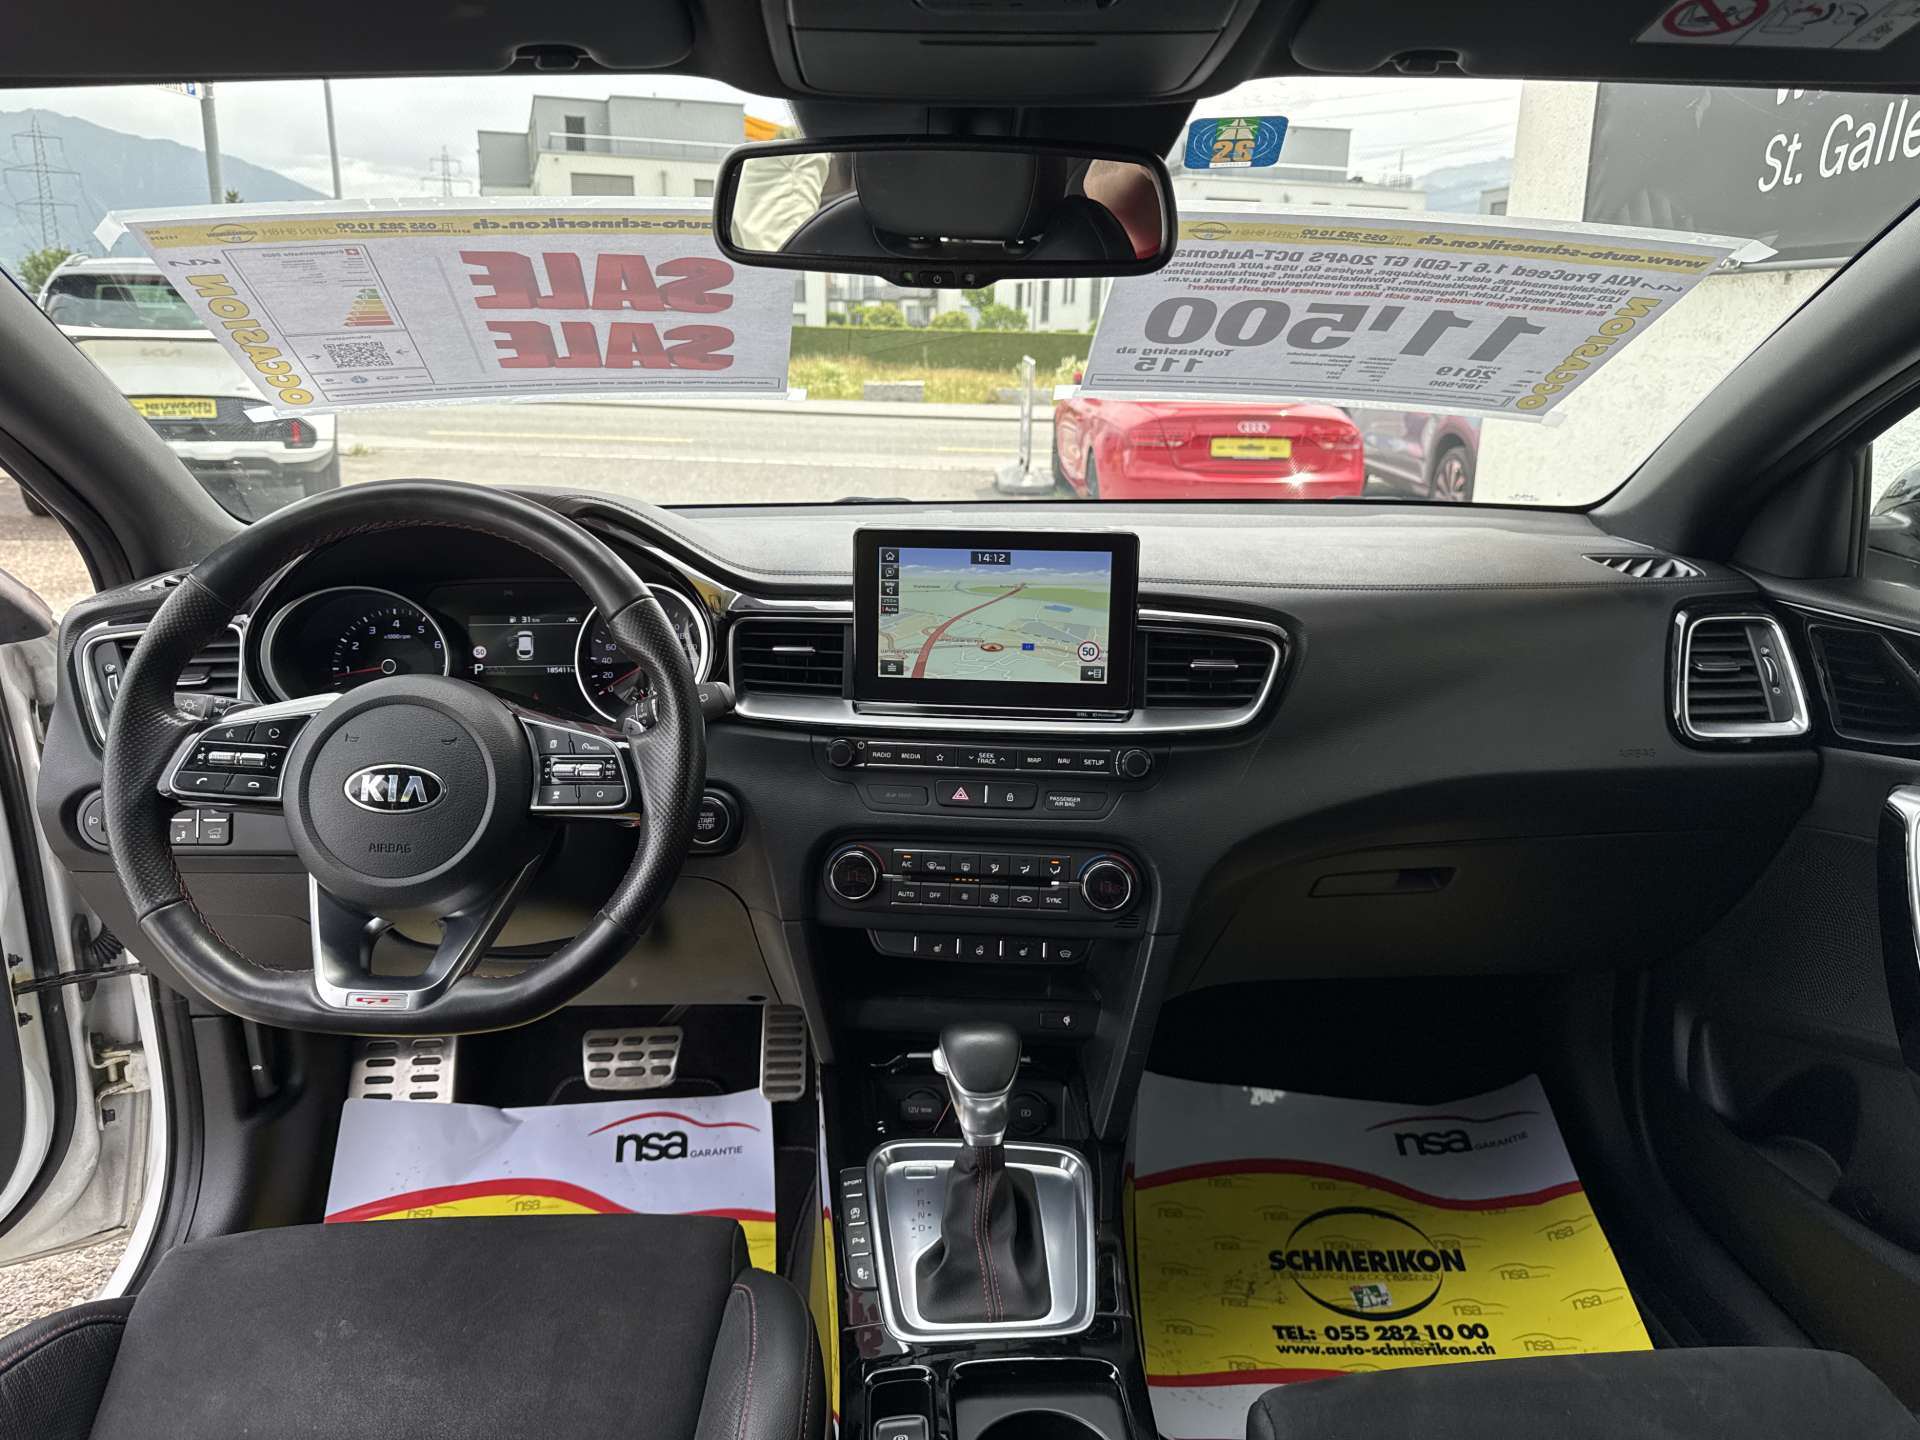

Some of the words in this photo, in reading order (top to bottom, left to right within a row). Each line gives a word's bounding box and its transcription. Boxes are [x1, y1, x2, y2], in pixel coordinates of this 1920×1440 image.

[1758, 132, 1803, 192] St.
[977, 552, 1006, 564] 14:12
[392, 619, 401, 628] 4
[368, 626, 377, 635] 3
[417, 625, 425, 634] 5
[351, 641, 360, 650] 2
[433, 640, 442, 649] 6
[605, 643, 617, 651] 60
[1082, 647, 1095, 657] 50
[601, 657, 613, 665] 40
[474, 663, 484, 675] P
[602, 671, 614, 679] 20
[607, 684, 614, 693] 0
[872, 751, 892, 759] RADIO
[901, 752, 921, 760] MEDIA
[976, 757, 997, 765] TRACK
[1057, 757, 1071, 765] NAV
[1083, 758, 1105, 766] SETUP
[360, 775, 428, 803] KIA
[1049, 795, 1081, 803] PASSENGER
[368, 842, 412, 854] AIRBAG
[897, 890, 914, 898] AUTO
[929, 891, 941, 899] OFF
[1045, 896, 1062, 904] SYNC
[615, 1130, 688, 1163] nsa
[689, 1144, 744, 1159] GARANTIE
[1394, 1129, 1474, 1156] nsa
[1474, 1131, 1529, 1151] GARANTIE
[843, 1178, 863, 1187] SPORT
[514, 1198, 542, 1212] nsa
[1547, 1224, 1574, 1241] nsa
[1268, 1249, 1468, 1273] SCHMERIKON
[1500, 1267, 1530, 1281] nsa
[1572, 1293, 1602, 1311] nsa
[1452, 1303, 1483, 1317] nsa
[1272, 1325, 1317, 1341] TEL:
[1324, 1325, 1370, 1341] 055
[1374, 1325, 1420, 1341] 282
[1424, 1324, 1454, 1340] 10
[1457, 1323, 1489, 1340] 00
[1276, 1340, 1497, 1357] www.auto-schmerikon.ch
[1523, 1337, 1555, 1352] nsa
